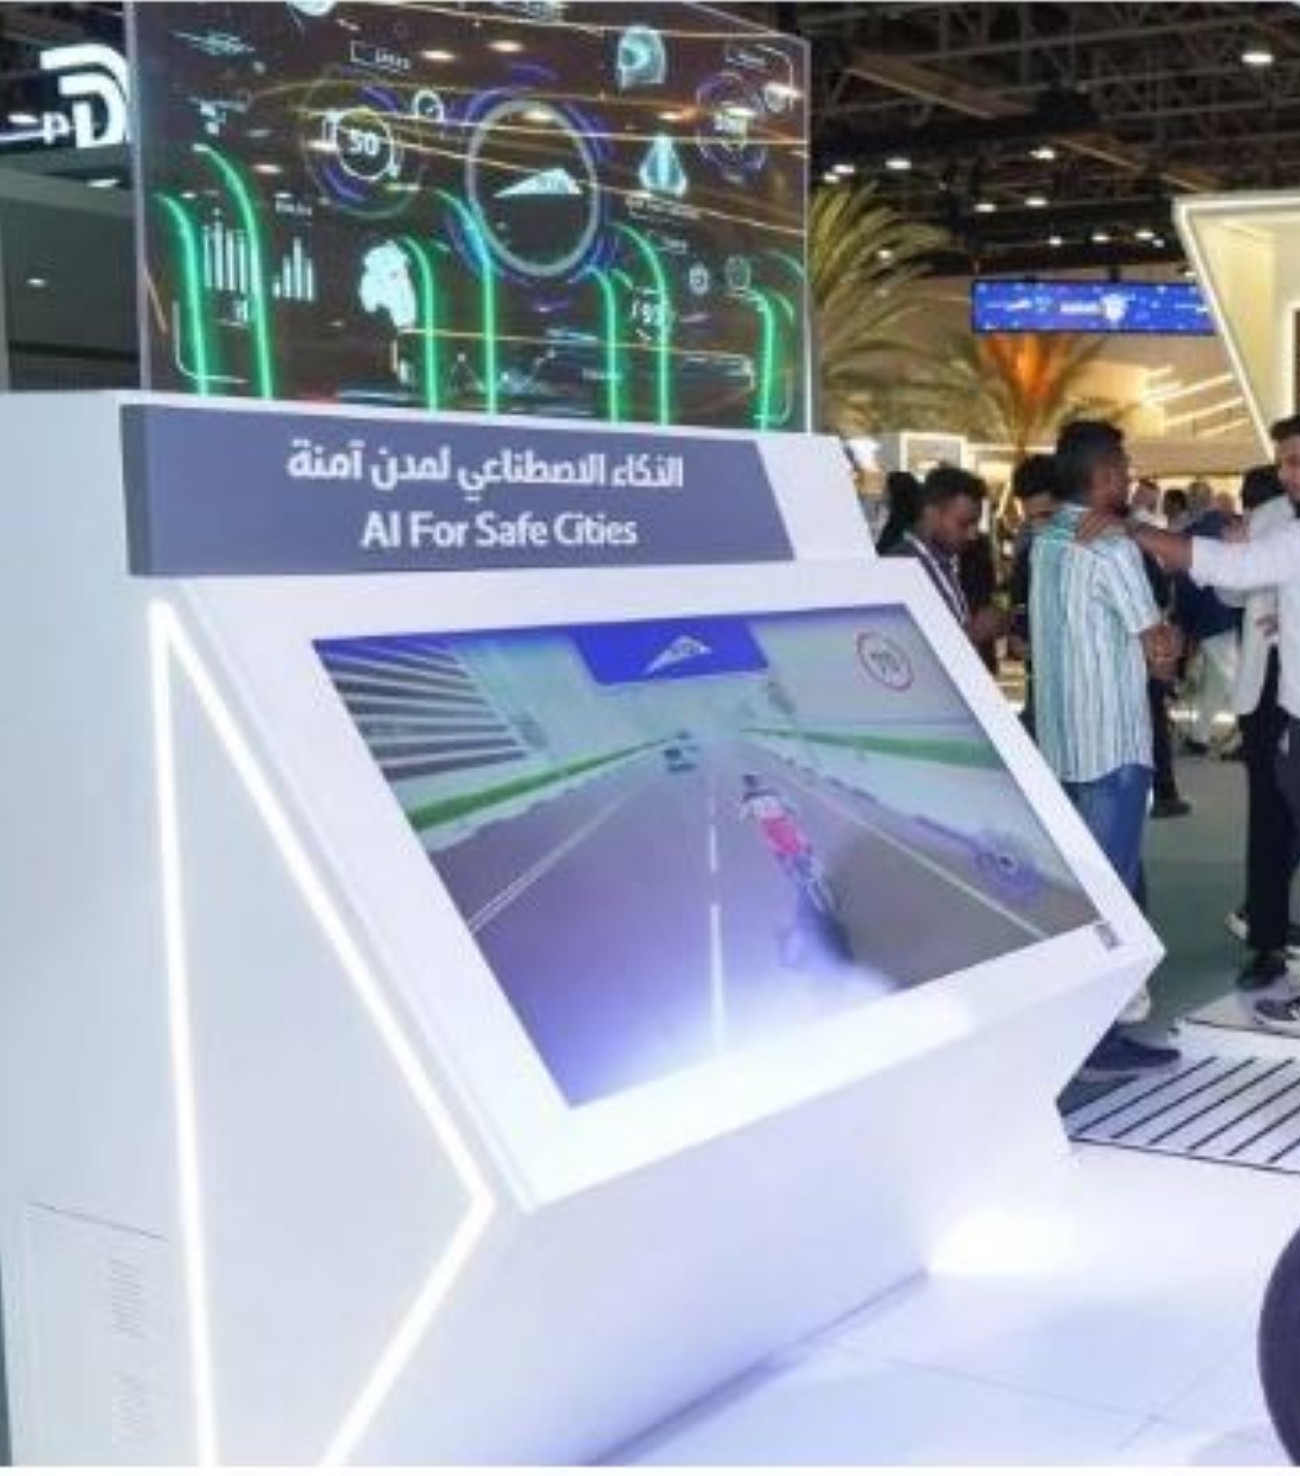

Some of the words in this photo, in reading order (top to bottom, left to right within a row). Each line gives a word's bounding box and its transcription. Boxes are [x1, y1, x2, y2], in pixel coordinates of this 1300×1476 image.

[286, 439, 365, 482] آمنة
[371, 446, 452, 491] لمدن
[361, 511, 399, 549] AI
[409, 511, 468, 549] For
[475, 511, 549, 549] Safe
[553, 511, 639, 547] Cities
